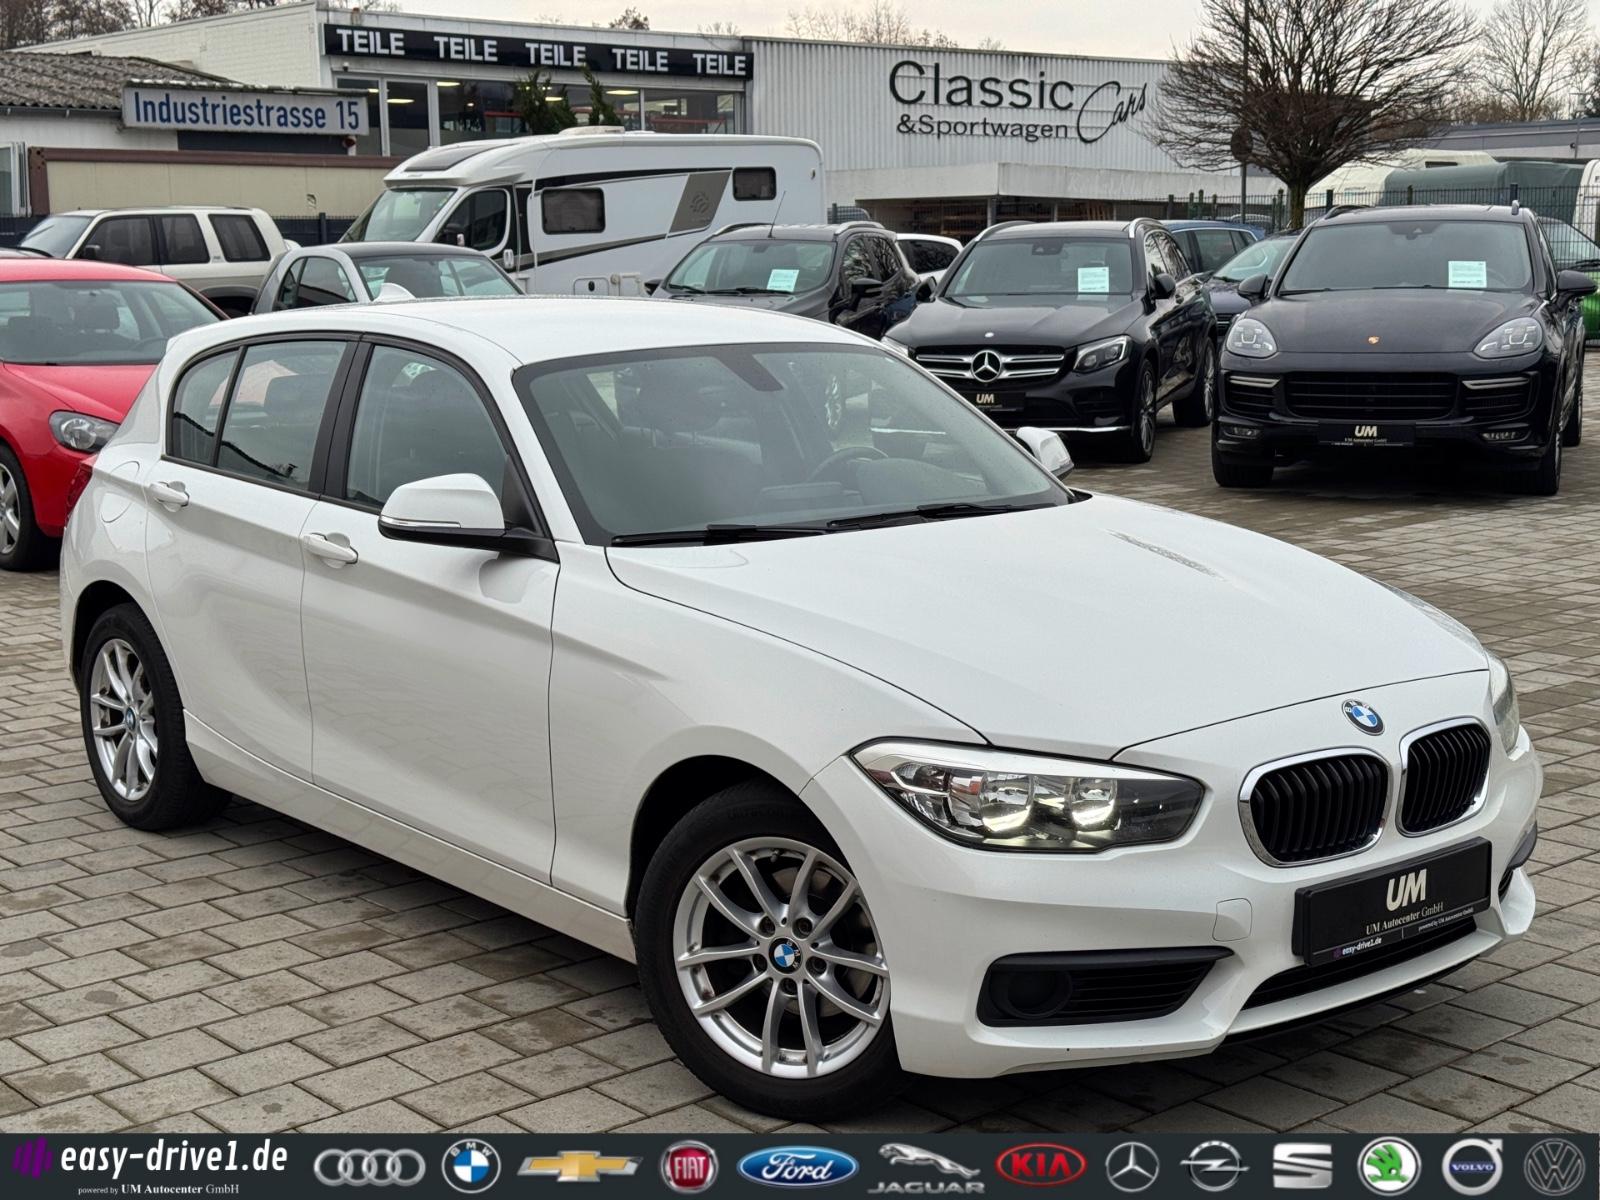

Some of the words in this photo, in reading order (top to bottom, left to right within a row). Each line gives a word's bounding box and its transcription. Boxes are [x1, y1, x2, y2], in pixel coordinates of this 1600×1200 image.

[336, 28, 405, 55] TEILE
[433, 36, 498, 62] TEILE
[525, 42, 586, 67] TEILE
[612, 48, 669, 72] TEILE
[692, 53, 746, 76] TEILE
[134, 91, 326, 129] Industriestrasse
[335, 101, 360, 130] 15
[889, 60, 1075, 111] Classic
[1076, 81, 1147, 144] Cars
[896, 113, 1068, 143] &Sportwagen
[976, 393, 995, 404] UM
[1354, 425, 1378, 437] UM
[1386, 868, 1427, 912] UM
[1366, 922, 1381, 935] UM
[1382, 911, 1420, 931] Autocenter
[1421, 902, 1444, 916] GmbH
